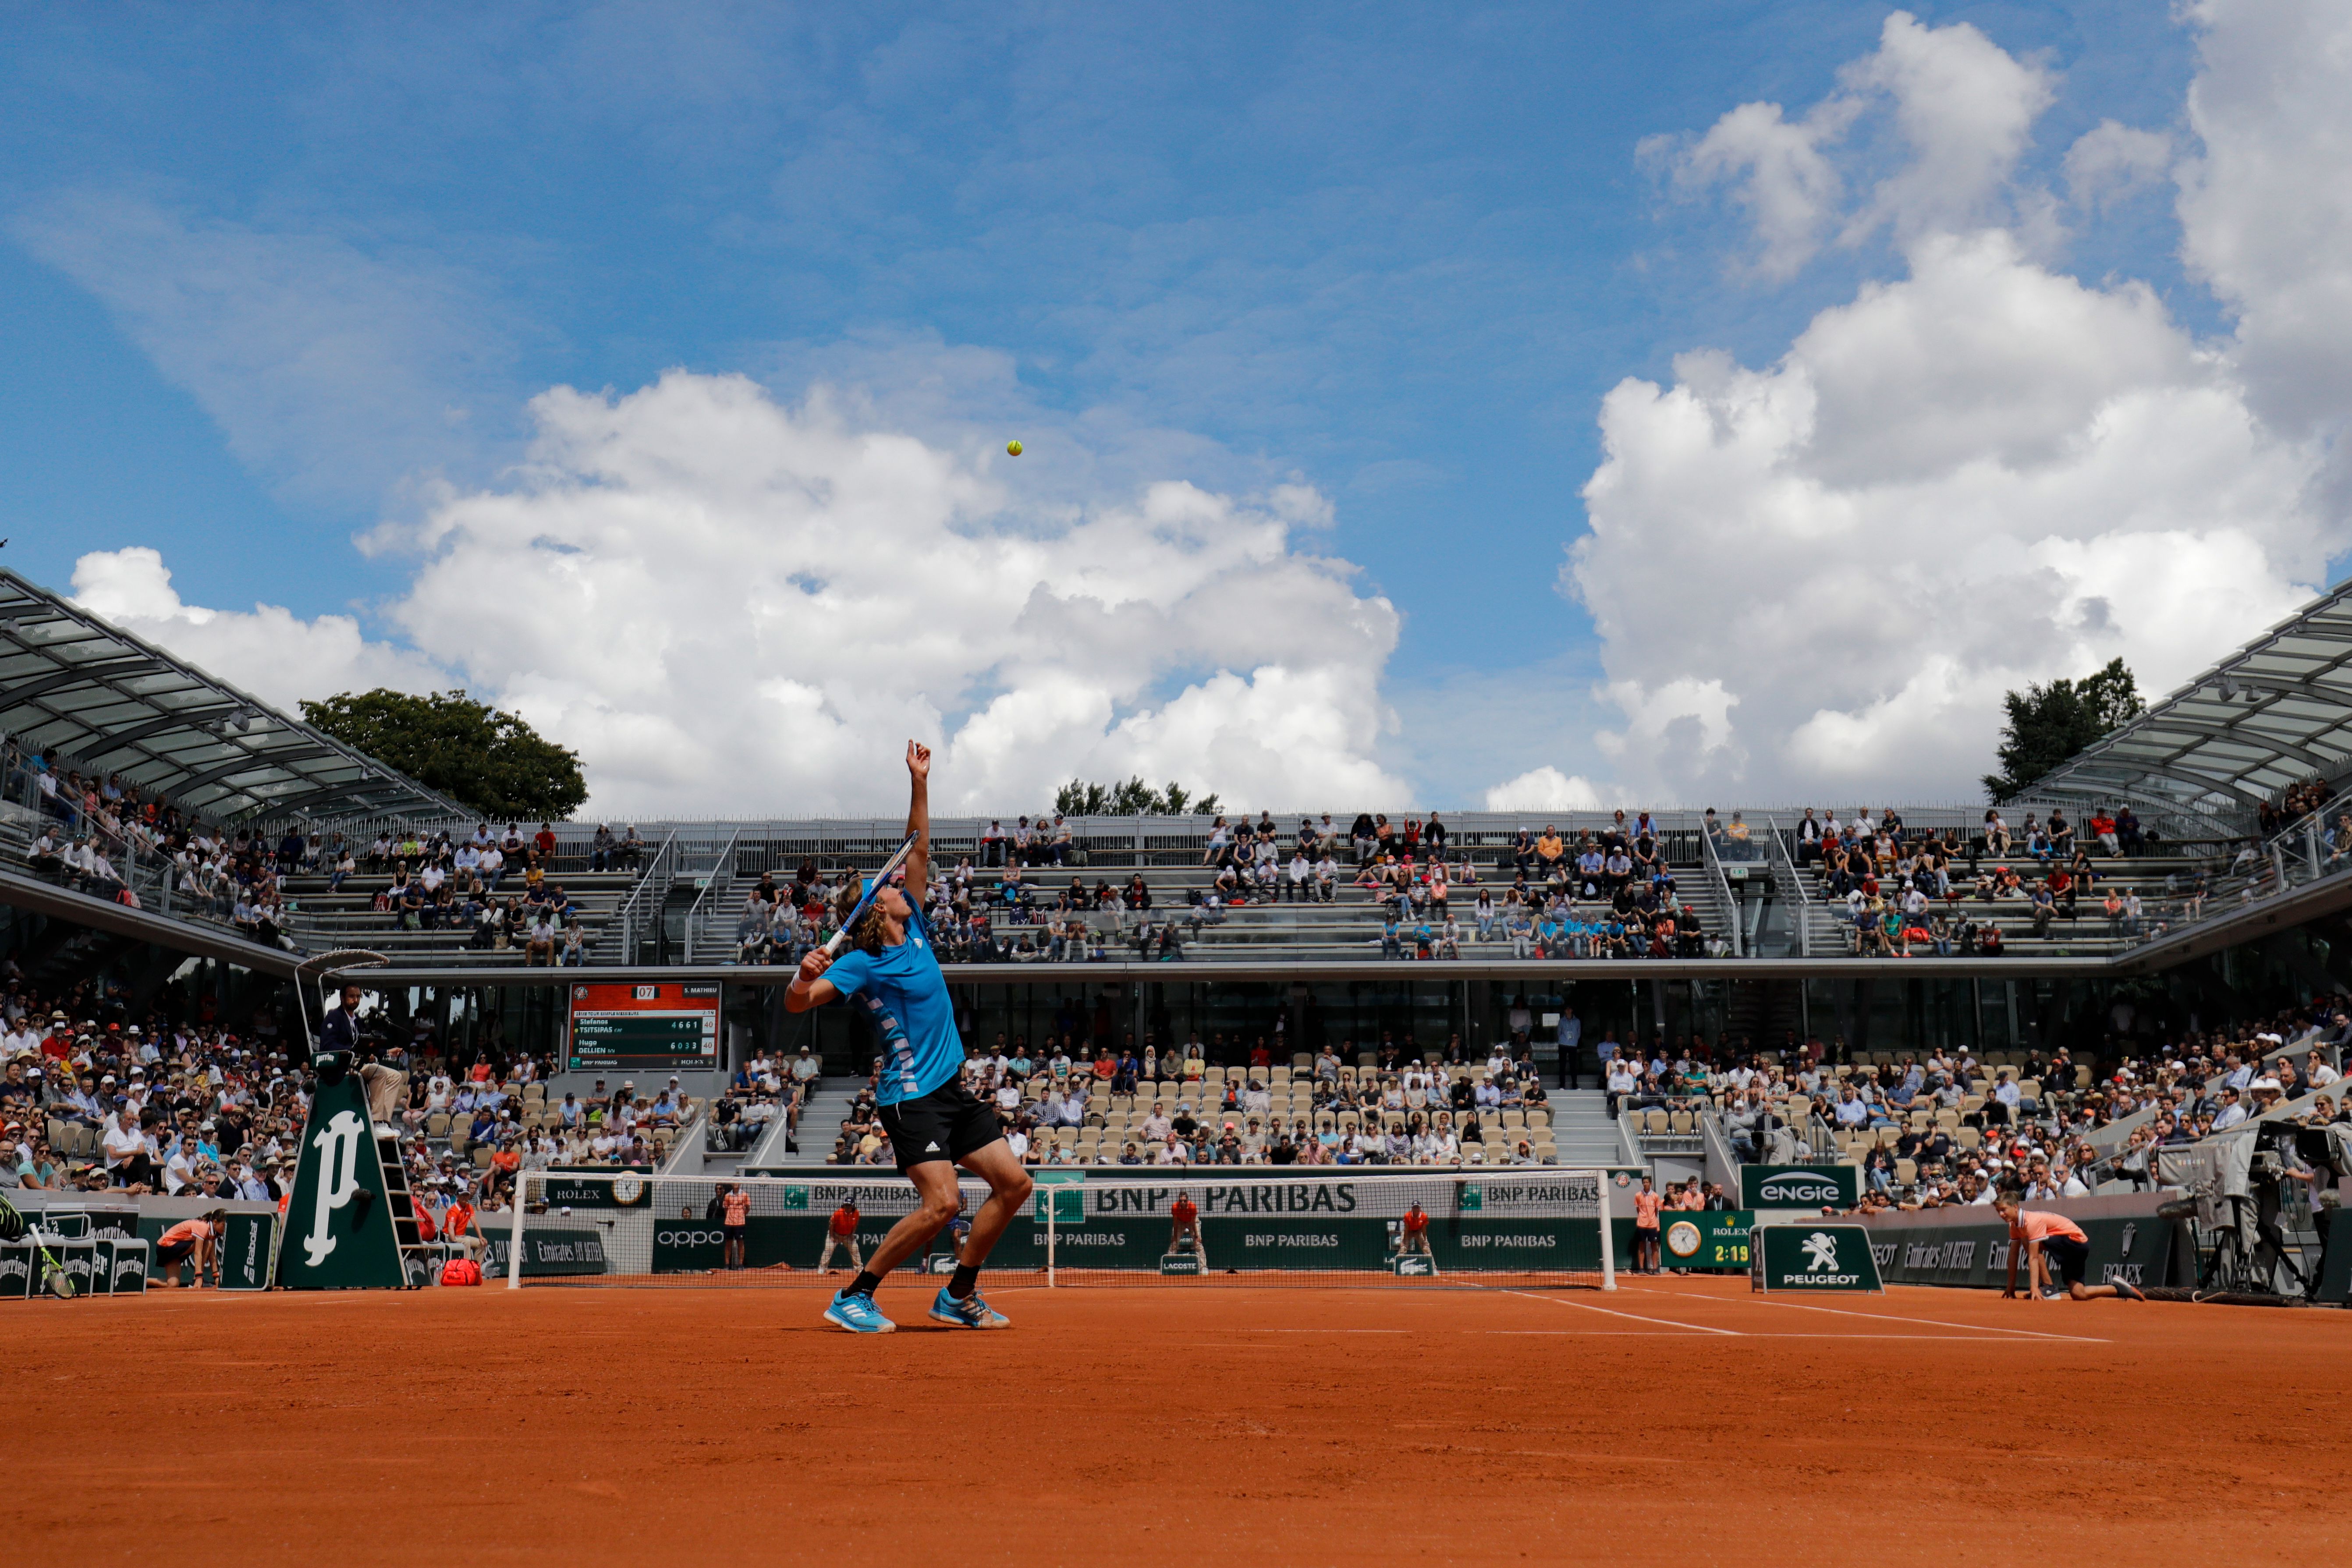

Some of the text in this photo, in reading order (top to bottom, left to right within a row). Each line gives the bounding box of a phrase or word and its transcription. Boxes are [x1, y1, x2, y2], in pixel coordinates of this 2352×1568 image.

[639, 987, 652, 997] 07
[316, 1052, 335, 1068] perrier
[557, 1189, 600, 1199] ROLEX
[814, 1186, 922, 1200] BNP PARIBAS
[1097, 1183, 1356, 1212] BNP PARIBAS
[1489, 1186, 1600, 1201] BNP PARIBAS
[1066, 1233, 1125, 1245] PARIBAS
[1713, 1227, 1749, 1236] ROLEX
[246, 1220, 259, 1266] Babolat
[657, 1231, 724, 1249] oppo
[1245, 1234, 1338, 1246] BNP PARIBAS
[1462, 1235, 1556, 1247] BNP PARIBAS
[537, 1240, 574, 1262] Emirates
[1715, 1245, 1749, 1262] 2:19
[1904, 1241, 1941, 1268] Emirates
[114, 1256, 144, 1287] perrier
[1784, 1274, 1860, 1284] PEUGEOT
